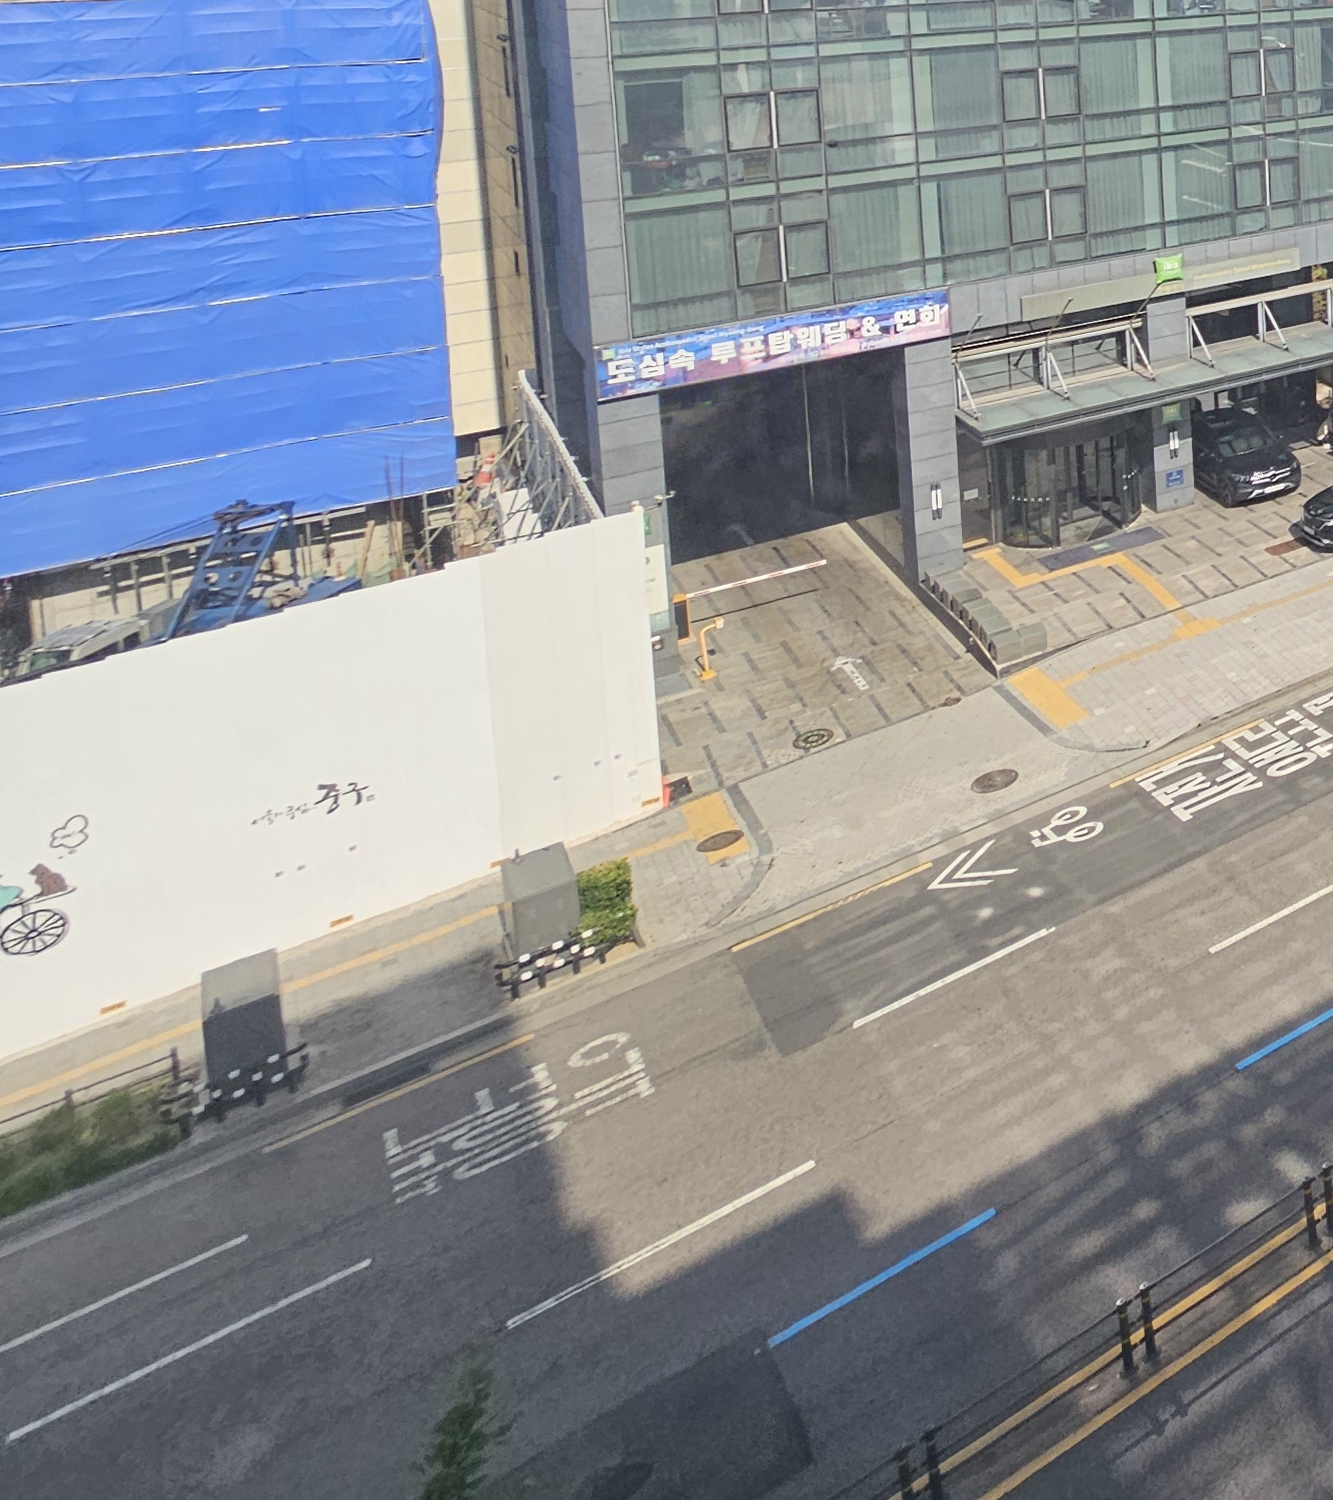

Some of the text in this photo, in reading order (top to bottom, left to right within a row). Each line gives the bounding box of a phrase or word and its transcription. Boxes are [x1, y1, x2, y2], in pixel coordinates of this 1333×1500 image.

[606, 348, 696, 385] 도심속
[711, 320, 848, 364] 루프탑웨딩
[862, 317, 882, 337] &
[1134, 745, 1264, 823] 자전거
